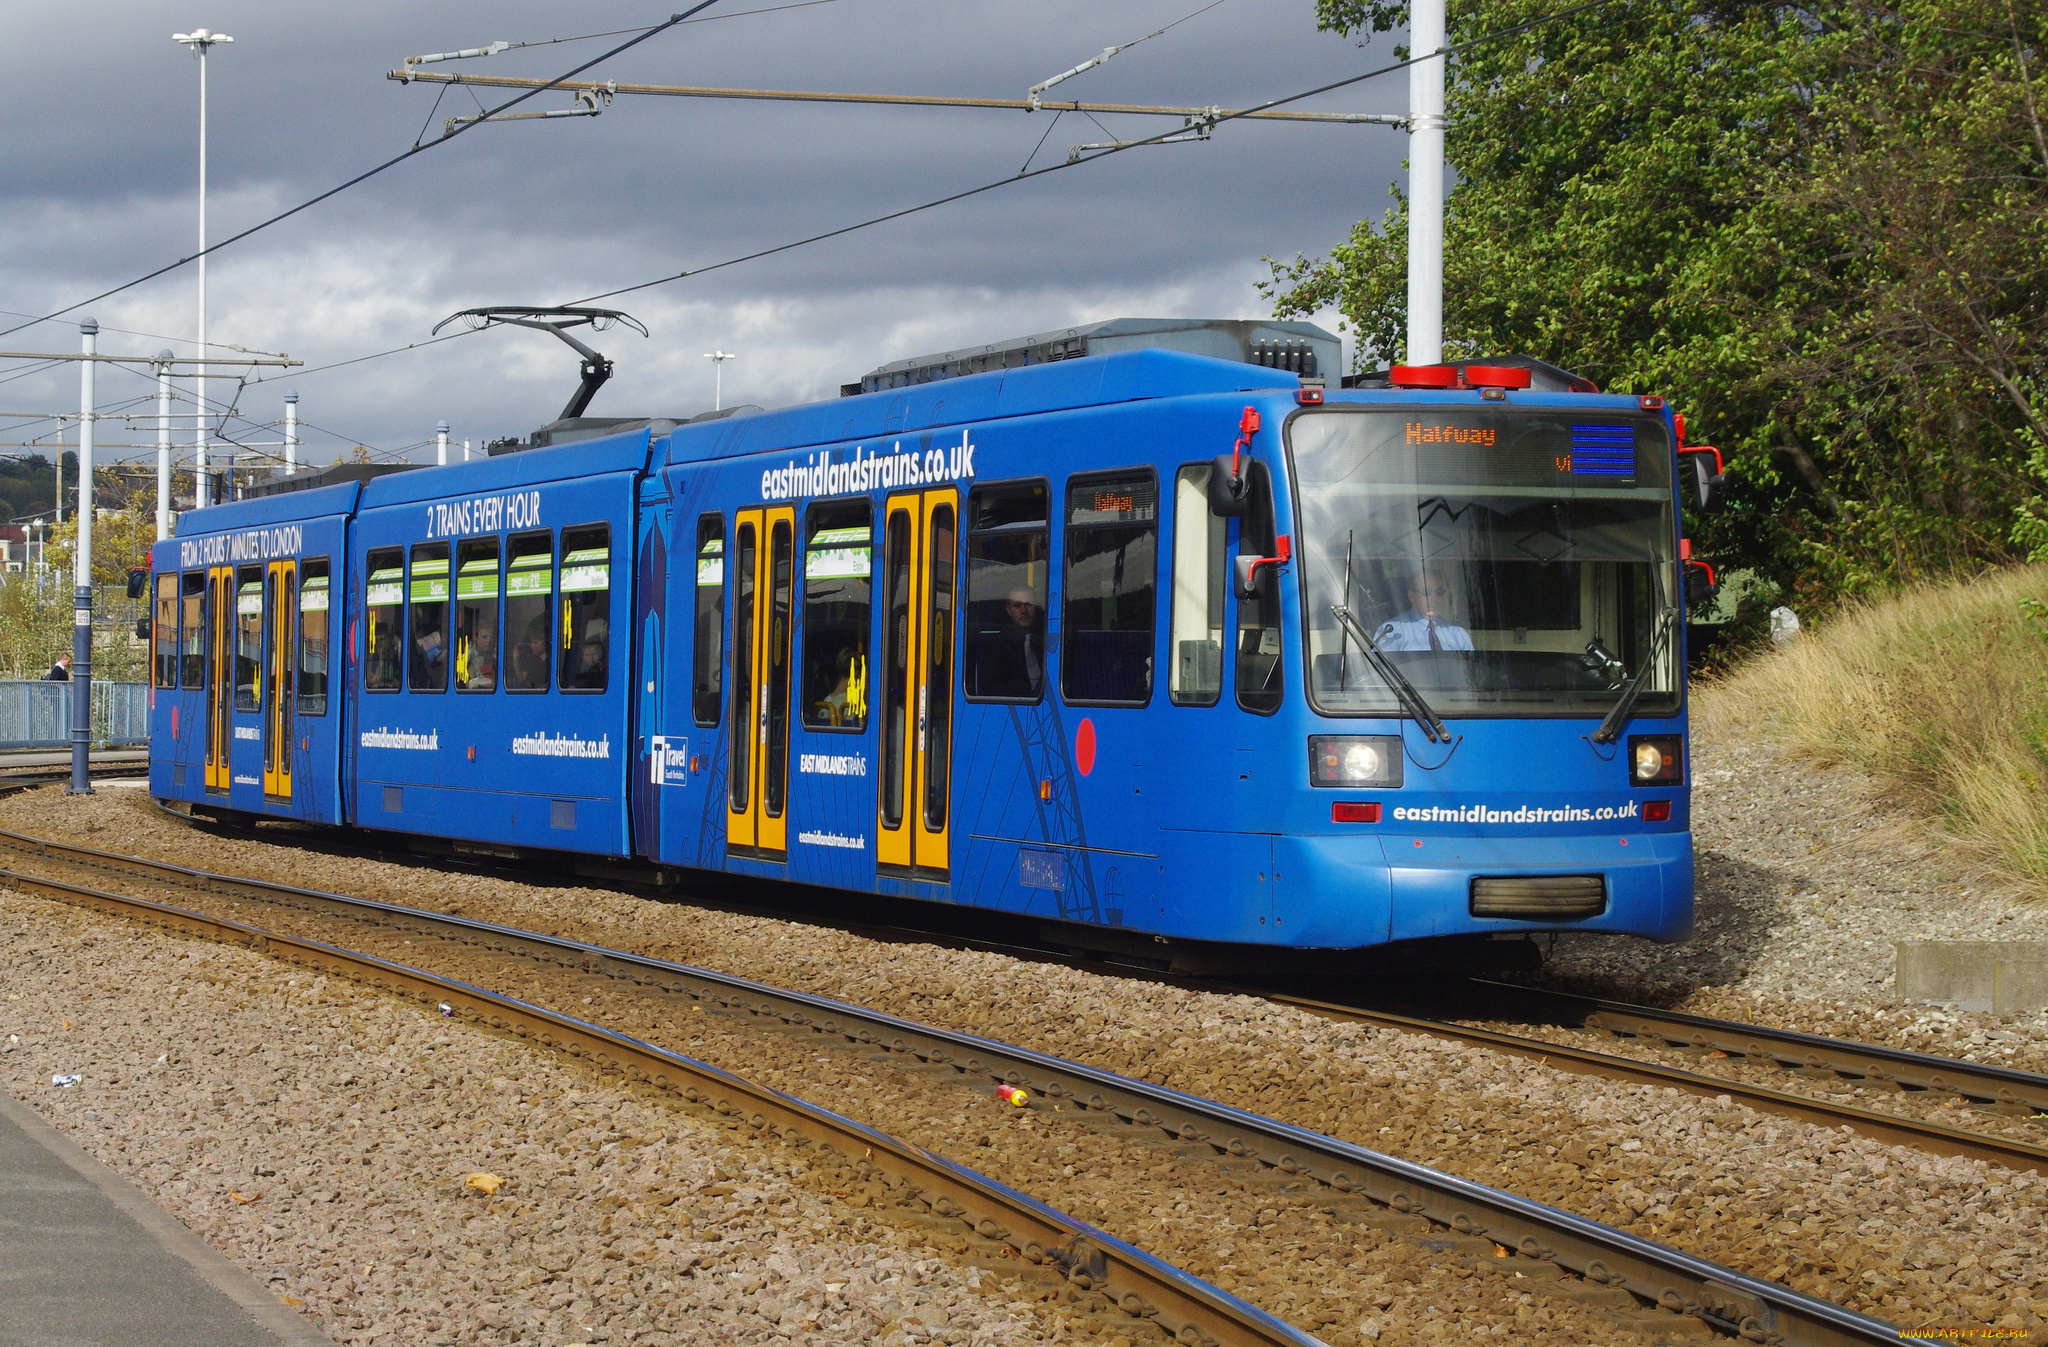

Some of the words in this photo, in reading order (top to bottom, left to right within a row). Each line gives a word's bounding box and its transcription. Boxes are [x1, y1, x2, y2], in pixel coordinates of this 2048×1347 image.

[1406, 422, 1496, 446] Halfway
[761, 429, 976, 500] eastmidlandstrains.co.uk
[427, 505, 434, 538] 2
[436, 500, 471, 537] TRAINS
[473, 495, 504, 533] EVERY
[506, 490, 540, 527] HOUR
[1094, 493, 1132, 512] Halfway
[181, 541, 198, 567] FROM
[198, 539, 203, 565] 2
[204, 535, 225, 564] HOURS
[226, 534, 231, 561] 7
[231, 530, 259, 561] MINUTES
[260, 529, 270, 559] TO
[270, 524, 302, 558] LONDON
[361, 726, 438, 750] eastmidlandstrains.co.uk
[512, 731, 610, 759] eastmidlandstrains.co.uk
[665, 743, 686, 767] Travel
[800, 754, 815, 773] EAST
[815, 755, 847, 775] MIDLANDS
[1393, 800, 1639, 824] eastmidlandstrains.co.uk
[799, 830, 865, 849] eastmidlandstrains.co.uk
